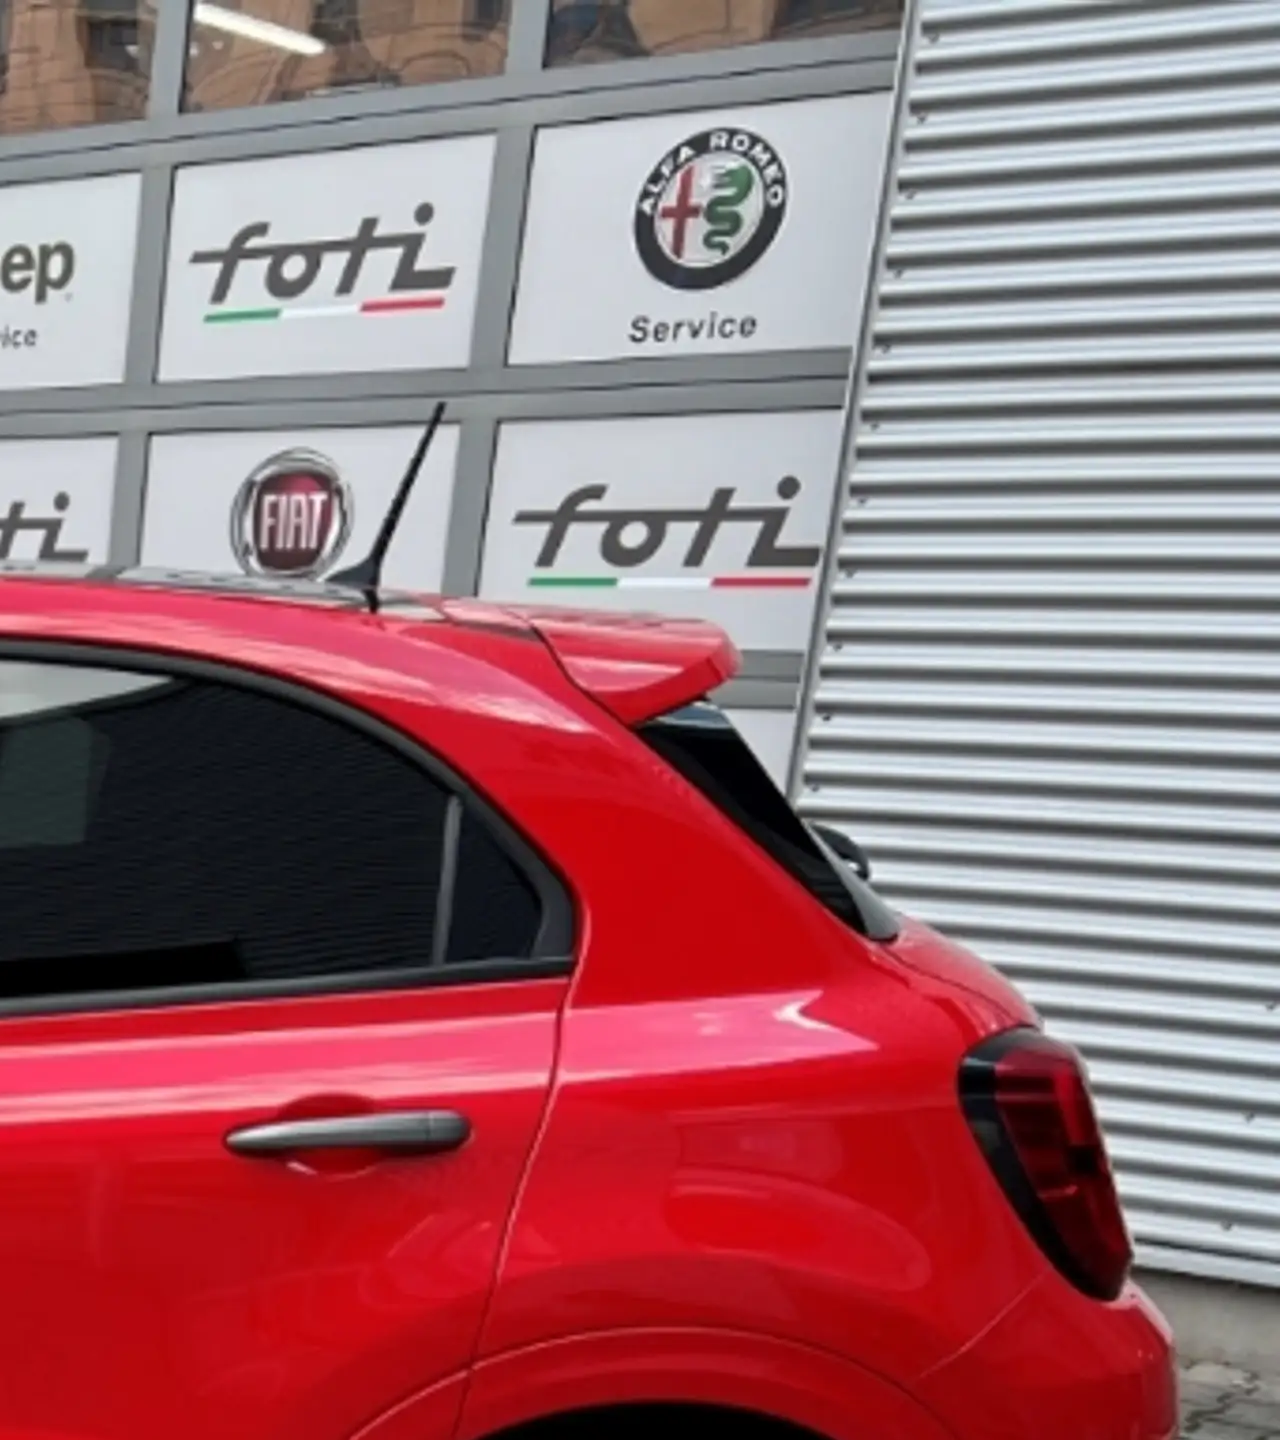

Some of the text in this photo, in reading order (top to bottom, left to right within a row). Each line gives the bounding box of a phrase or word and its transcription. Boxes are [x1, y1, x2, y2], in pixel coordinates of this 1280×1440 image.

[640, 130, 784, 215] ALFA ROMEO
[189, 202, 457, 305] foti
[628, 311, 758, 343] Service
[259, 491, 328, 551] FIAT
[512, 475, 822, 568] foti
